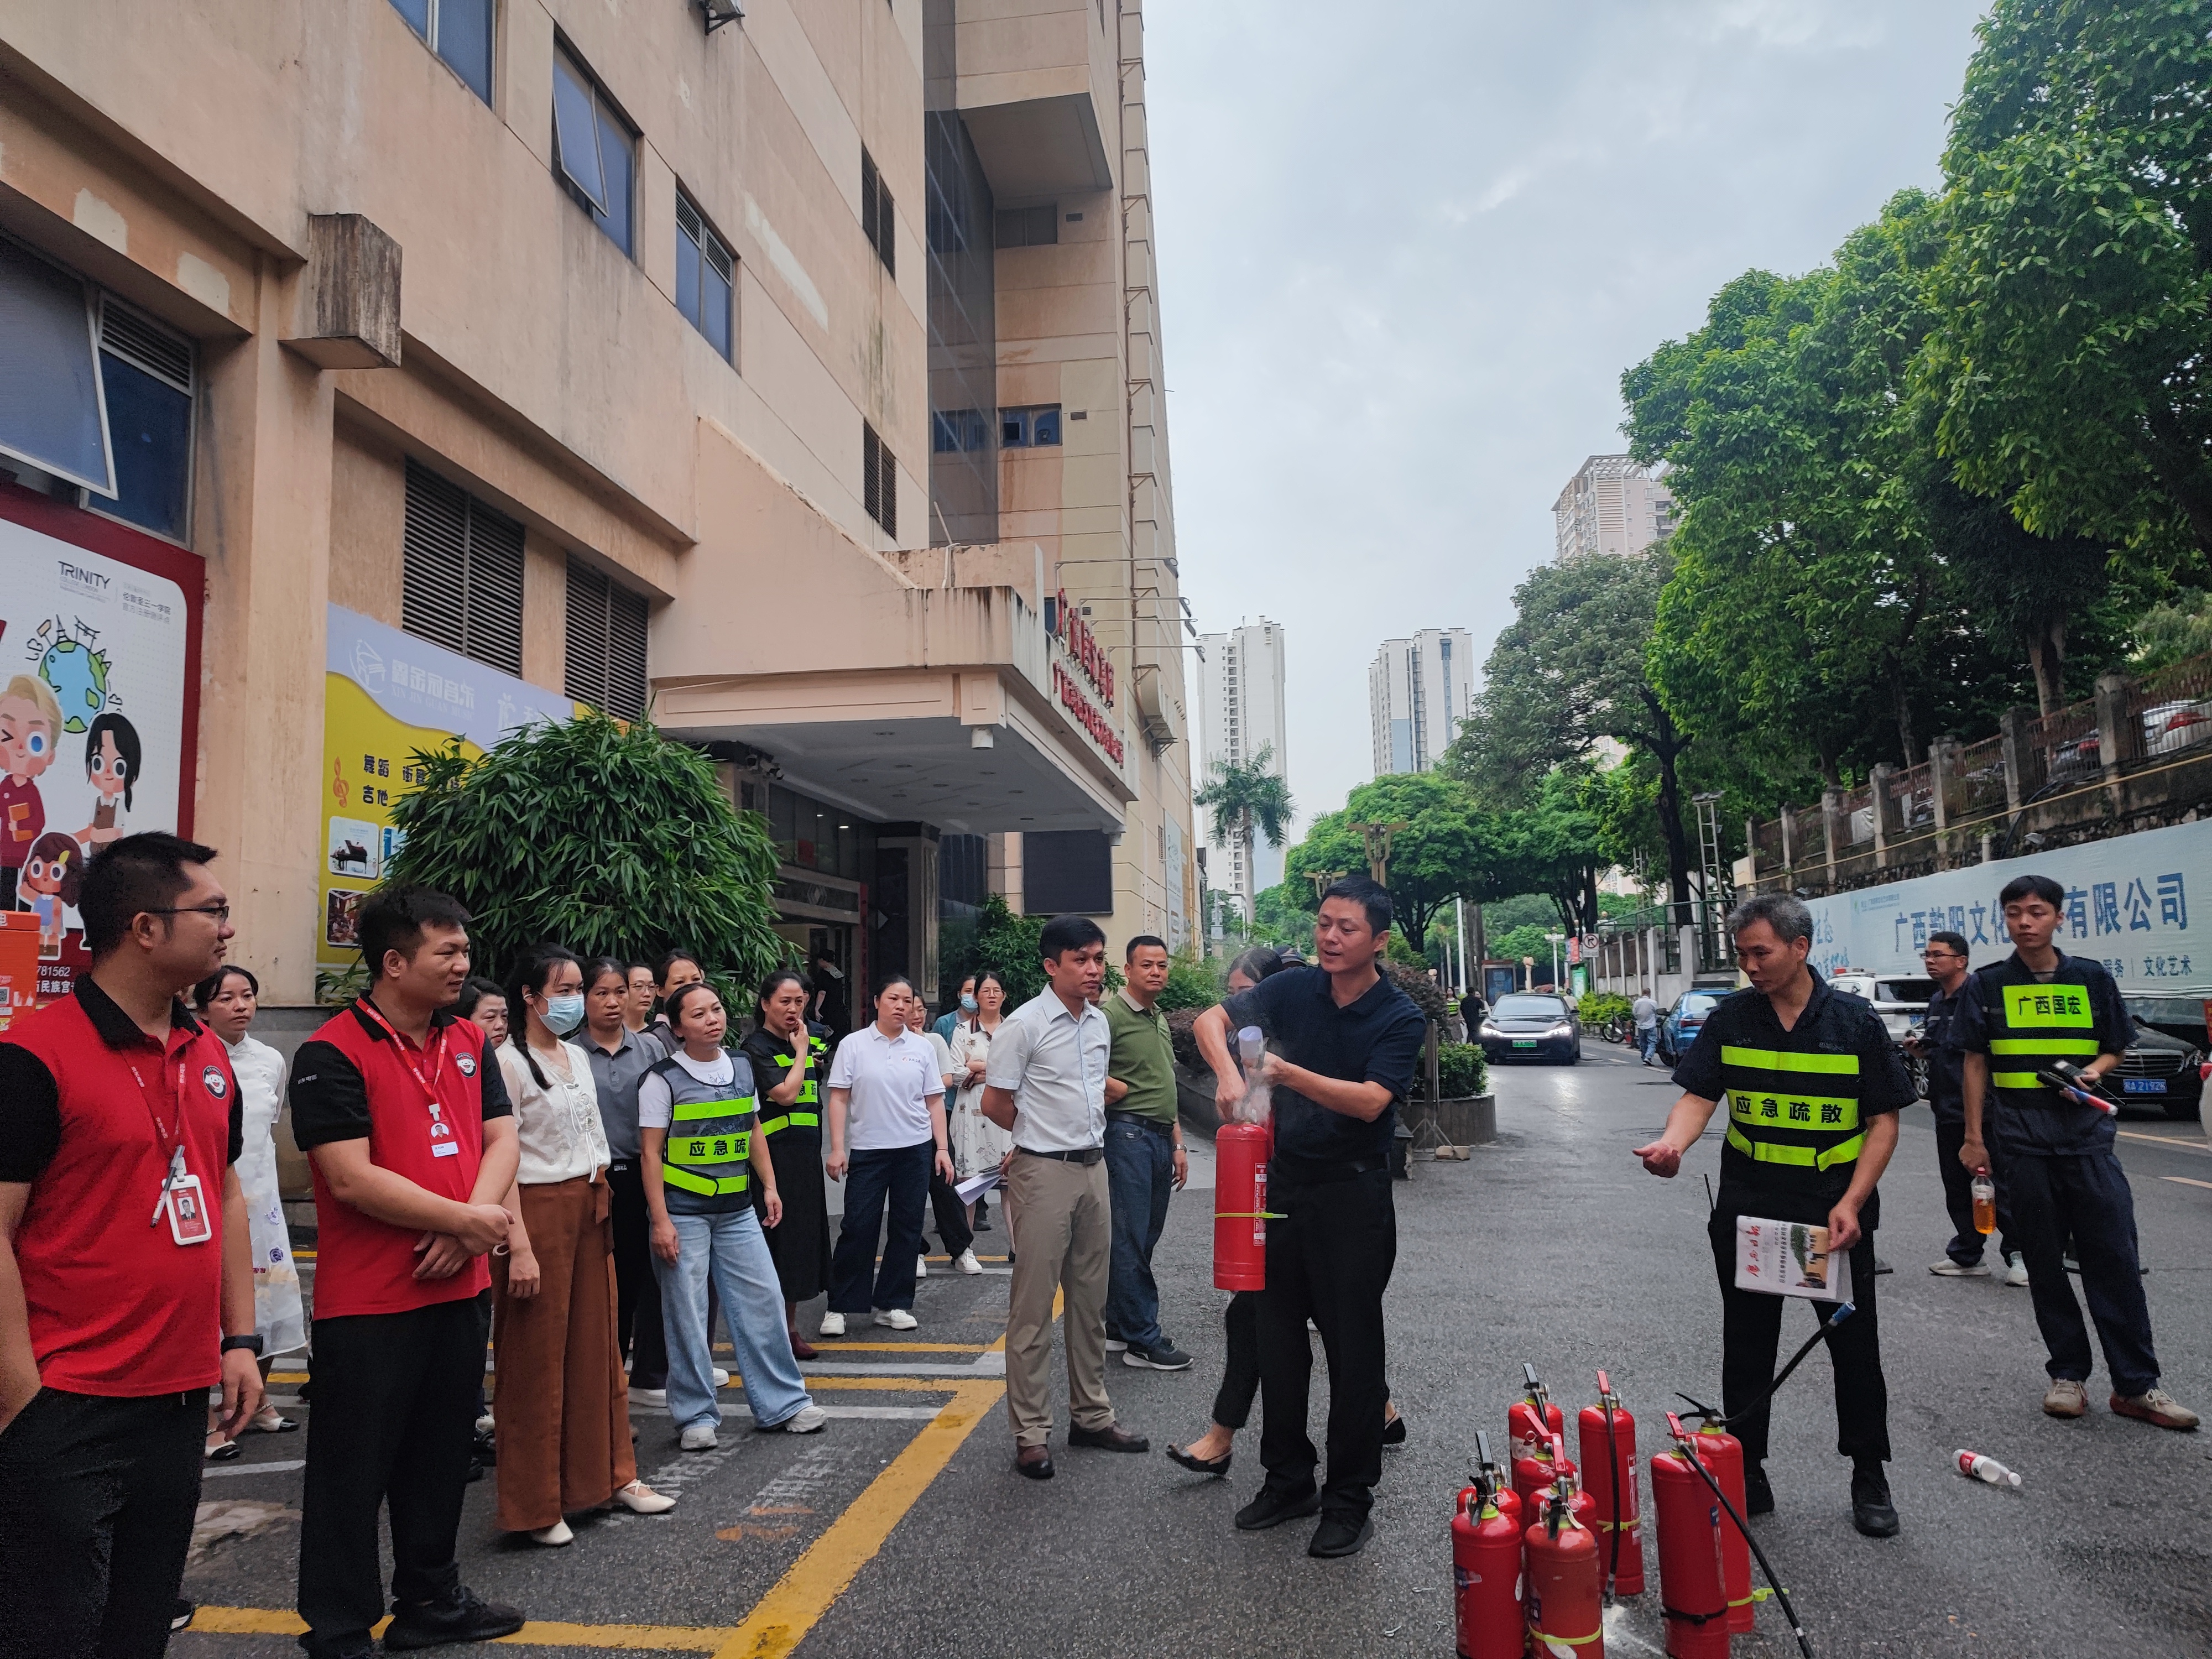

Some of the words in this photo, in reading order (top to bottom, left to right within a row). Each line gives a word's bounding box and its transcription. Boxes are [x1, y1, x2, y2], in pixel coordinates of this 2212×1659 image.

[58, 561, 111, 589] TRINITY
[363, 784, 389, 807] 吉他
[1735, 1096, 1843, 1124] 应急疏散
[689, 1138, 746, 1156] 应急疏
